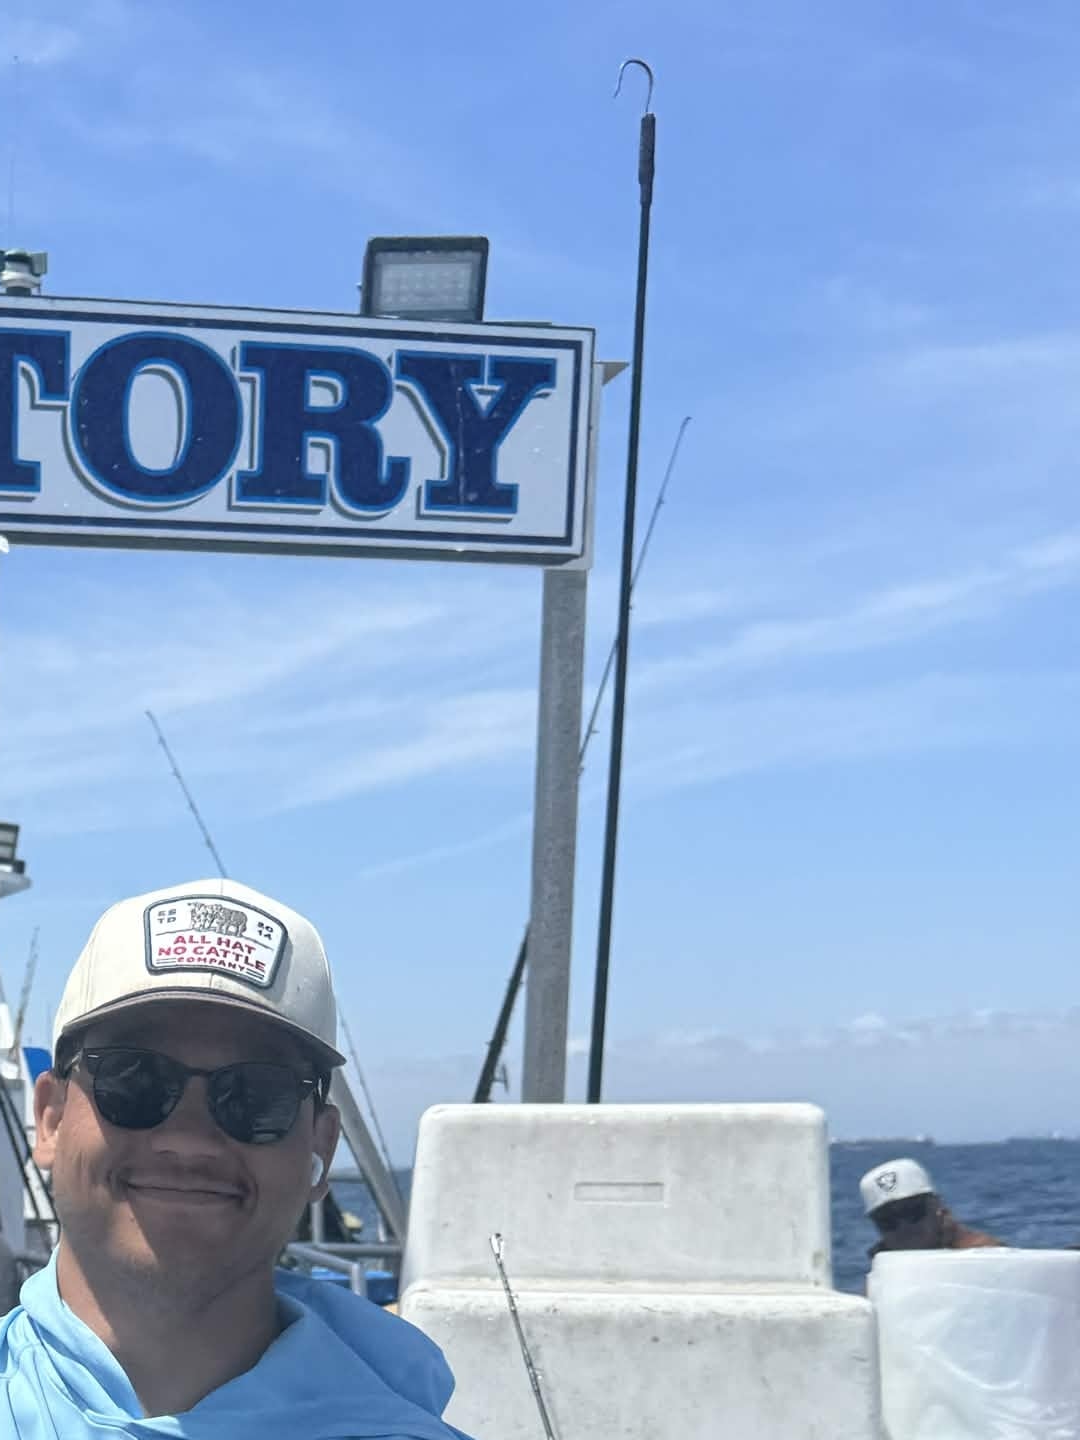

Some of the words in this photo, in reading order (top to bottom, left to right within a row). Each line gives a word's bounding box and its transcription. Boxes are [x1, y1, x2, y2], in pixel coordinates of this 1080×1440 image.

[173, 935, 211, 945] ALL
[216, 937, 256, 955] HAT
[158, 946, 187, 956] NO
[193, 946, 266, 973] CATTLE
[176, 957, 245, 971] COMPANY
